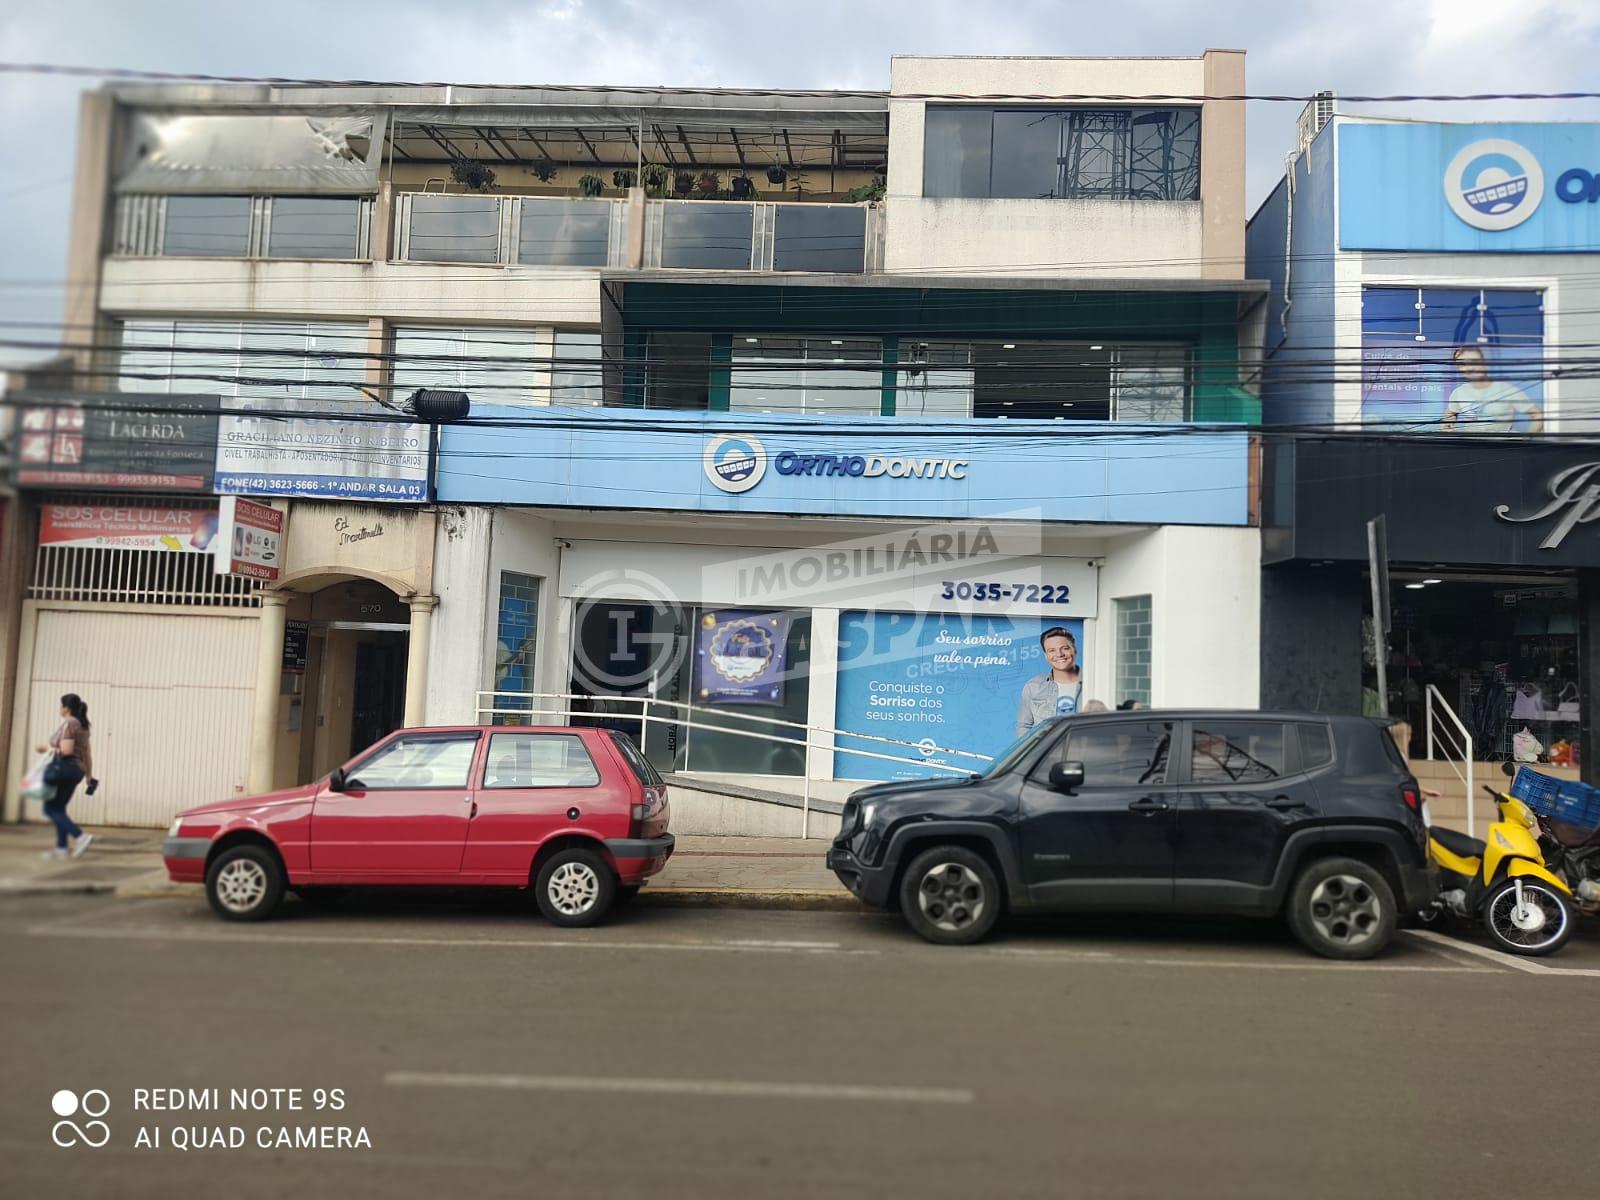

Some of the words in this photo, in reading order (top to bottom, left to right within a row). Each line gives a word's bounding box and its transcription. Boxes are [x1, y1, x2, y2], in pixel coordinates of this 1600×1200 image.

[1555, 168, 1600, 203] O
[1405, 383, 1418, 391] do
[269, 479, 319, 490] 3623-5666
[339, 482, 376, 493] ANDAR
[378, 484, 407, 495] SALA
[408, 485, 421, 495] 03
[52, 505, 94, 520] SOS
[99, 507, 192, 524] CELULAR
[251, 506, 280, 521] CELULAR
[941, 581, 1070, 604] 3035-7222
[935, 630, 961, 644] Seu
[963, 633, 1013, 647] sorriso
[933, 649, 962, 664] vale
[964, 655, 973, 664] a
[974, 655, 1011, 668] pena.
[868, 680, 933, 695] Conquiste
[936, 685, 945, 694] o
[870, 694, 916, 707] Sorriso
[919, 696, 943, 708] dos
[866, 711, 895, 721] seus
[897, 710, 946, 723] sonhos.
